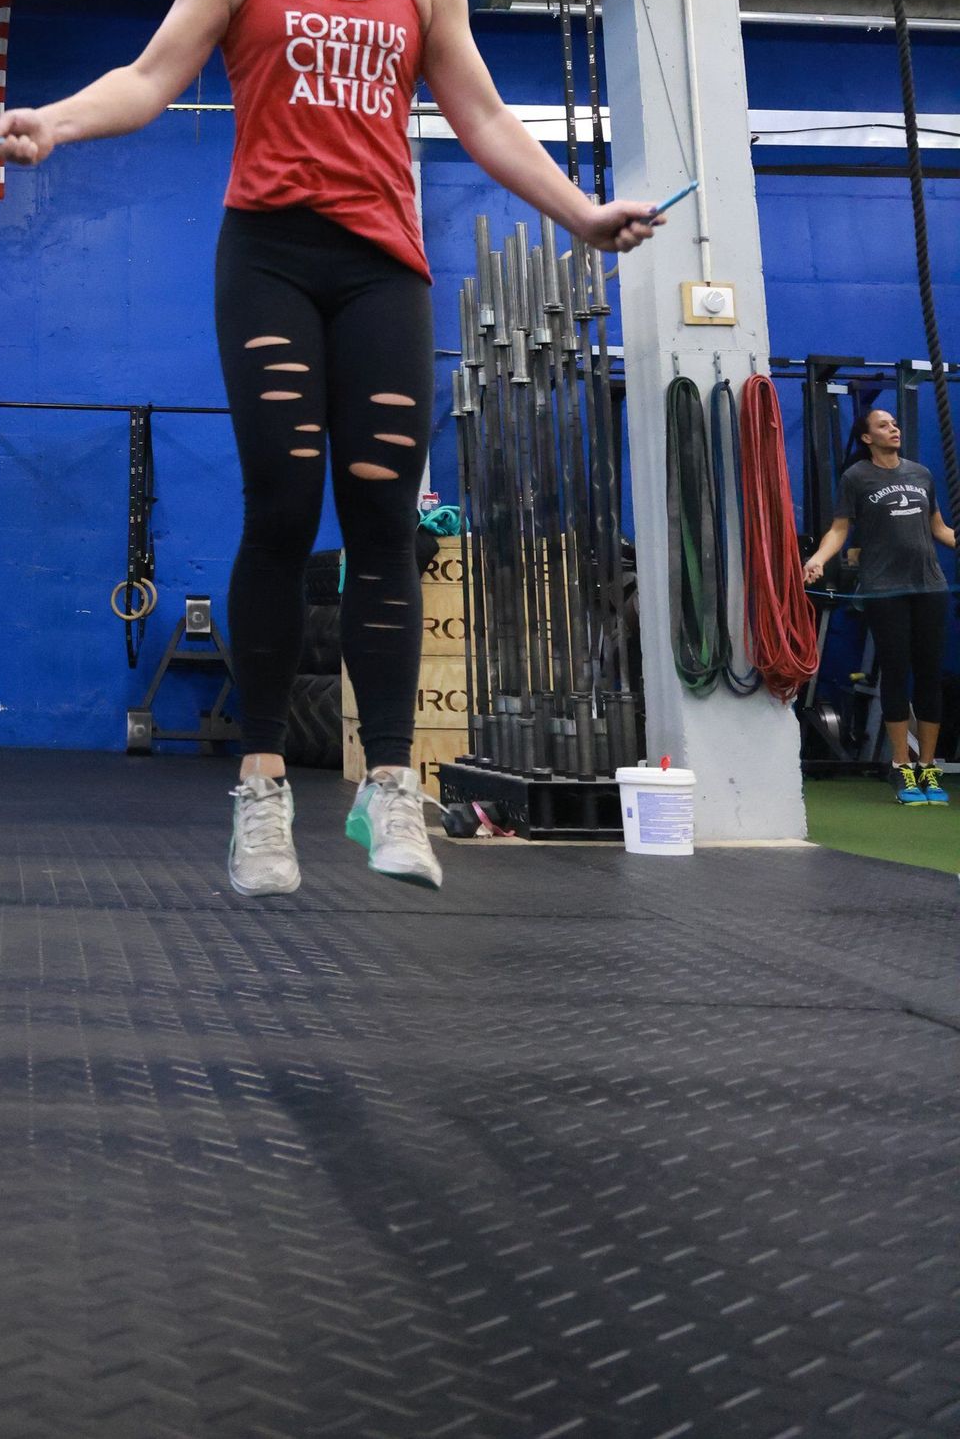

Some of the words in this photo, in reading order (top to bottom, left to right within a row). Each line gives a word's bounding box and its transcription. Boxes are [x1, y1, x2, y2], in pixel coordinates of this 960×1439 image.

[284, 11, 407, 54] FORTIUS
[286, 36, 401, 86] CITIUS
[288, 72, 395, 119] ALTIUS
[869, 484, 906, 504] CAROLINA
